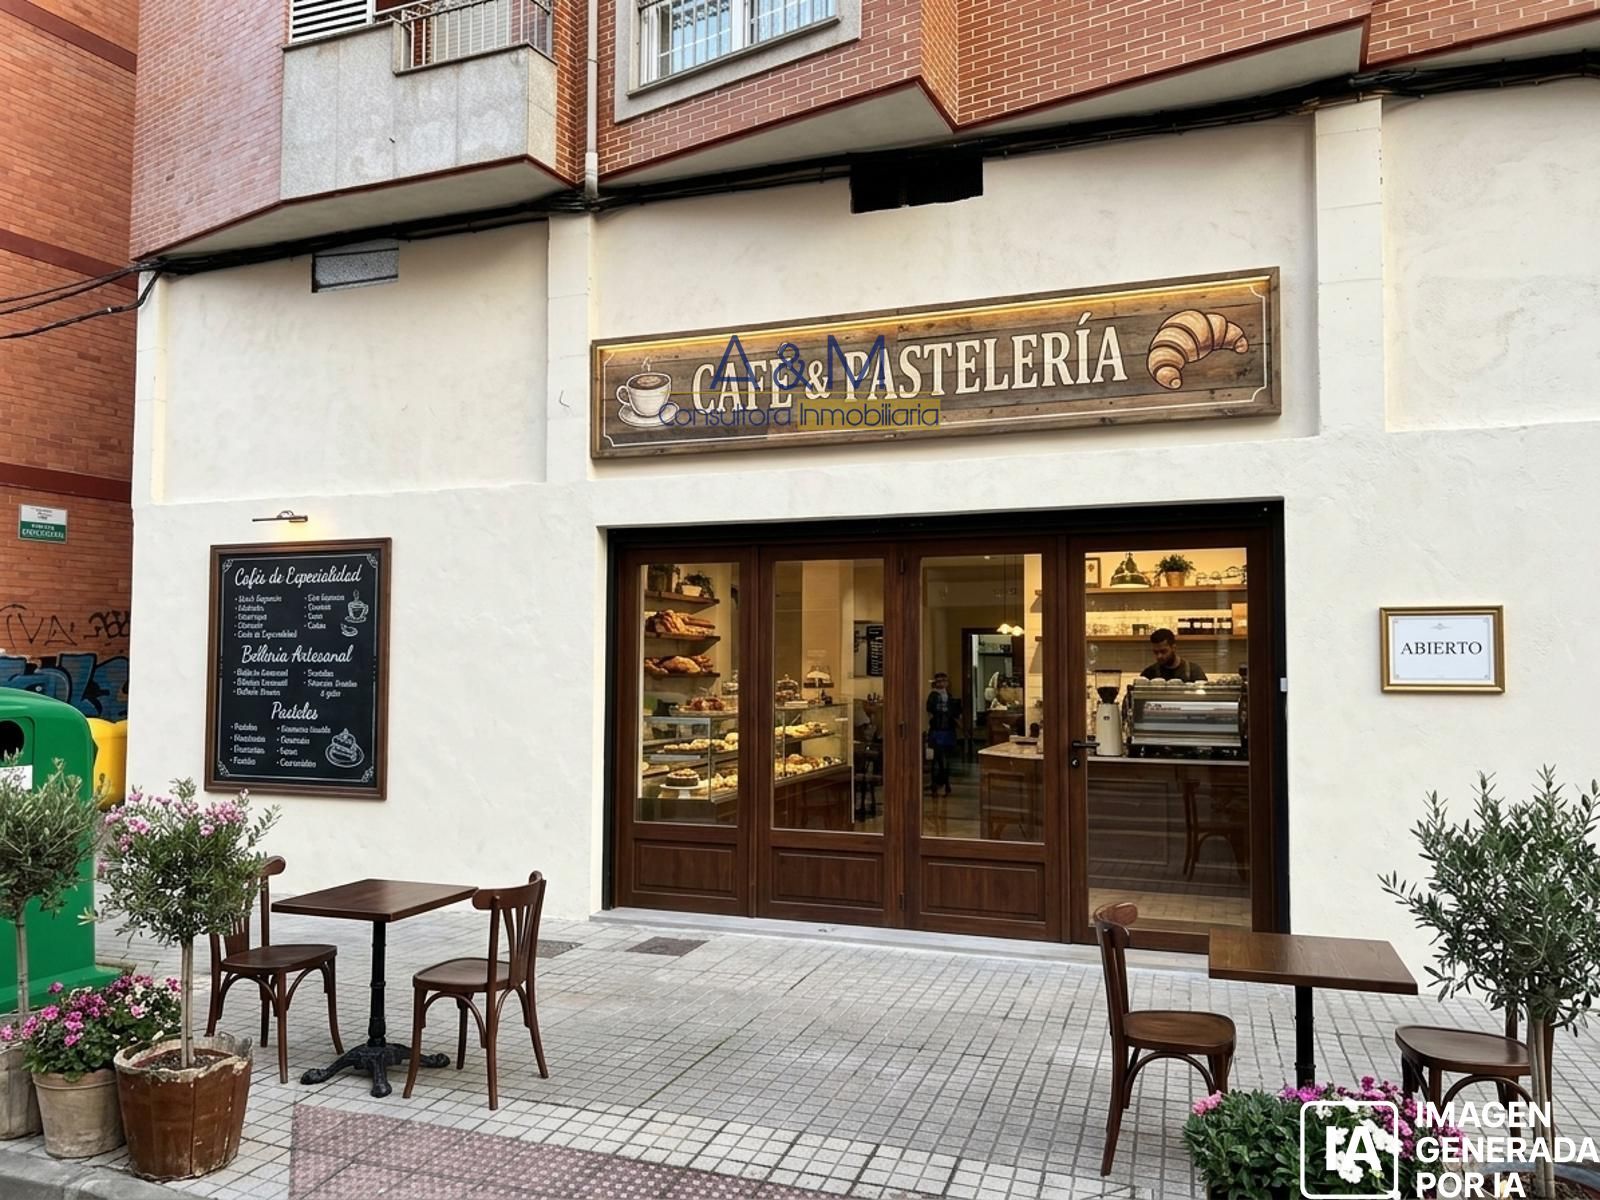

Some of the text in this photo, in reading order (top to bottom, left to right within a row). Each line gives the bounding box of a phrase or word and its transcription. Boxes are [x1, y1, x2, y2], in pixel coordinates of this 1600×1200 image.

[806, 359, 831, 400] &
[844, 311, 1128, 402] PASTELERÍA
[1400, 640, 1483, 655] ABIERTO
[271, 701, 319, 720] Pasteles
